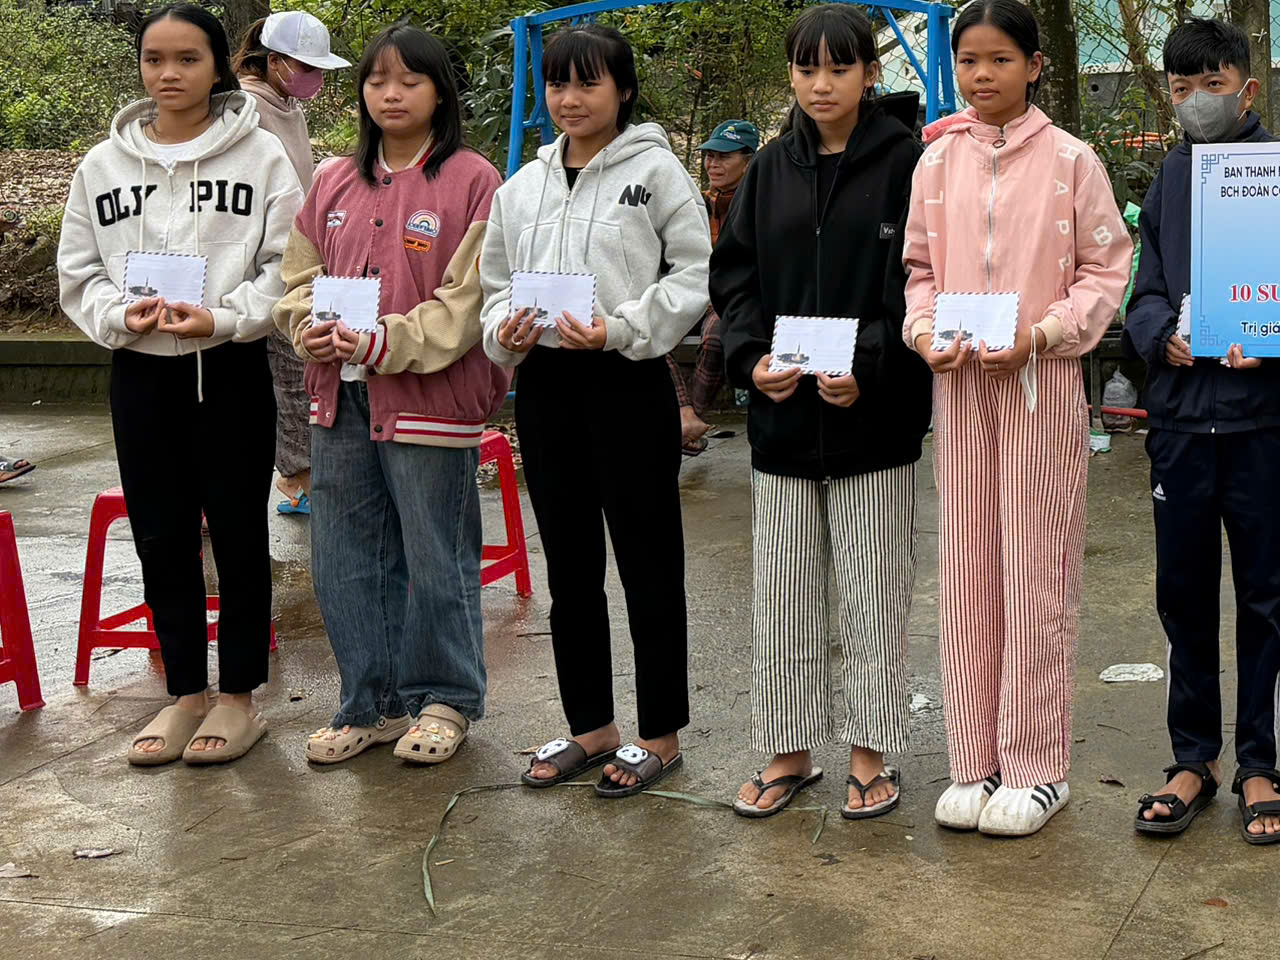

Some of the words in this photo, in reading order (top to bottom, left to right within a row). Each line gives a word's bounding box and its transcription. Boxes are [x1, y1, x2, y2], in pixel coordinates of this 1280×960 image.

[1224, 166, 1243, 178] BAN
[1245, 165, 1276, 178] THANH
[189, 180, 254, 217] PIO
[1220, 186, 1240, 197] BCH
[1230, 284, 1252, 302] 10
[1241, 321, 1257, 337] Trị
[1260, 321, 1280, 337] giá
